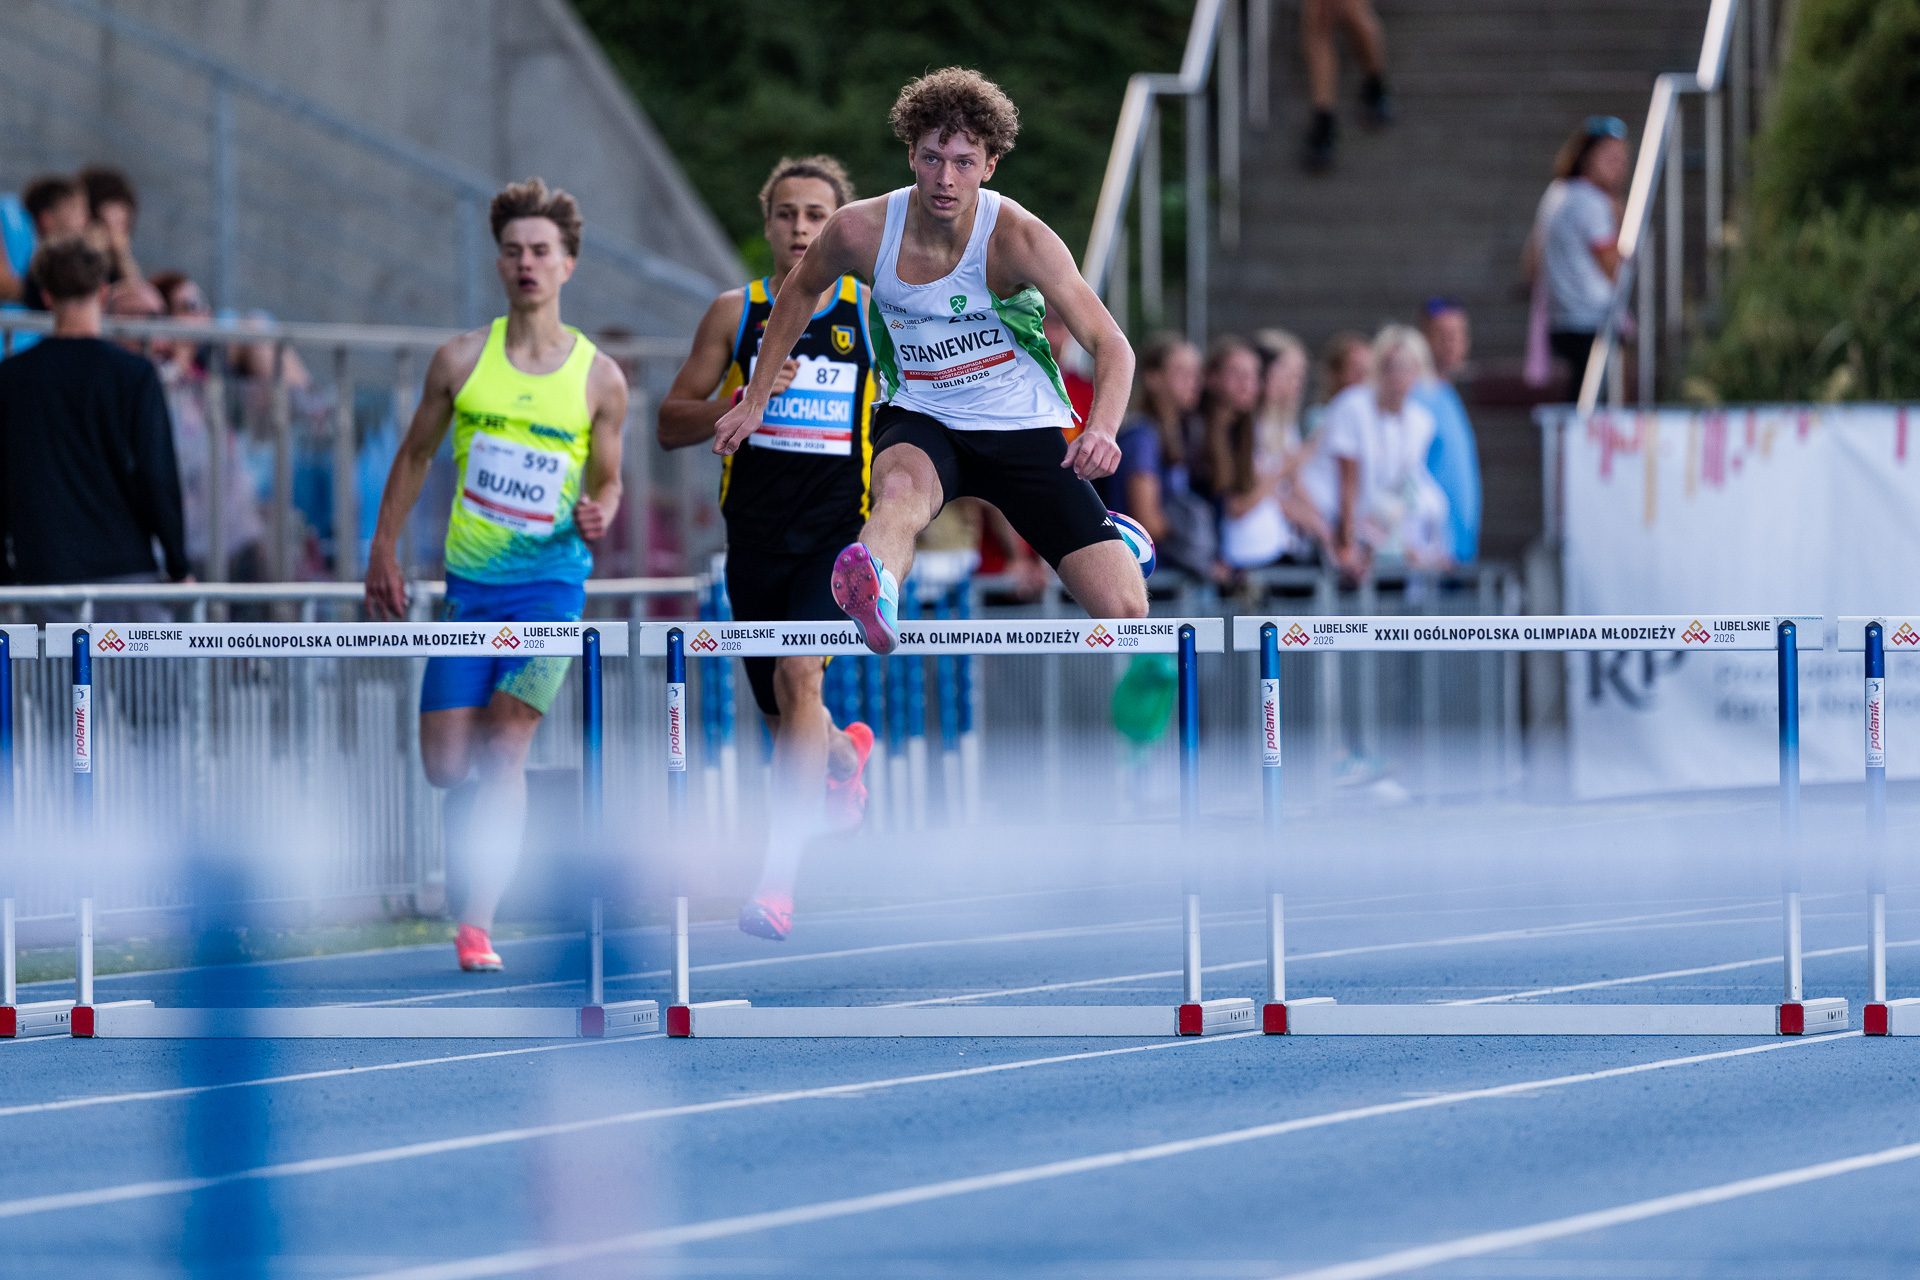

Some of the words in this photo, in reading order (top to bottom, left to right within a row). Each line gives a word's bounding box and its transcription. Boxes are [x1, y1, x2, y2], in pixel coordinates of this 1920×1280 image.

[899, 328, 1004, 363] STANIEWICZ
[816, 368, 840, 385] 87
[931, 377, 965, 390] LUBLIN
[966, 370, 990, 383] 2026
[765, 397, 849, 422] ZUCHALSKI
[523, 452, 559, 473] 593
[477, 469, 545, 503] BUJNO
[523, 626, 580, 638] LUBELSKIE
[720, 628, 776, 640] LUBELSKIE
[1117, 624, 1174, 636] LUBELSKIE
[1313, 623, 1368, 634] LUBELSKIE
[1374, 628, 1410, 641] XXXII
[1413, 625, 1520, 641] OGÓLNOPOLSKA
[1523, 627, 1597, 640] OLIMPIADA
[1601, 624, 1676, 640] MŁODZIEŻY
[1713, 620, 1771, 632] LUBELSKIE
[128, 629, 183, 641] LUBELSKIE
[188, 636, 223, 648] XXXII
[227, 633, 333, 648] OGÓLNOPOLSKA
[336, 634, 409, 647] OLIMPIADA
[412, 630, 486, 646] MŁODZIEŻY
[523, 638, 545, 649] 2026
[781, 633, 816, 646] XXXII
[820, 630, 925, 645] OGÓLNSKA
[929, 631, 1002, 645] OLIMPIADA
[1006, 628, 1081, 644] MŁODZIEŻY
[1117, 636, 1139, 647] 2026
[1313, 634, 1334, 645] 2026
[1713, 633, 1736, 643] 2026
[128, 641, 149, 652] 2026
[721, 640, 742, 651] 2026
[74, 707, 87, 757] polanik
[669, 705, 683, 755] polanik
[1264, 700, 1278, 750] polanik
[1869, 700, 1882, 750] polanik
